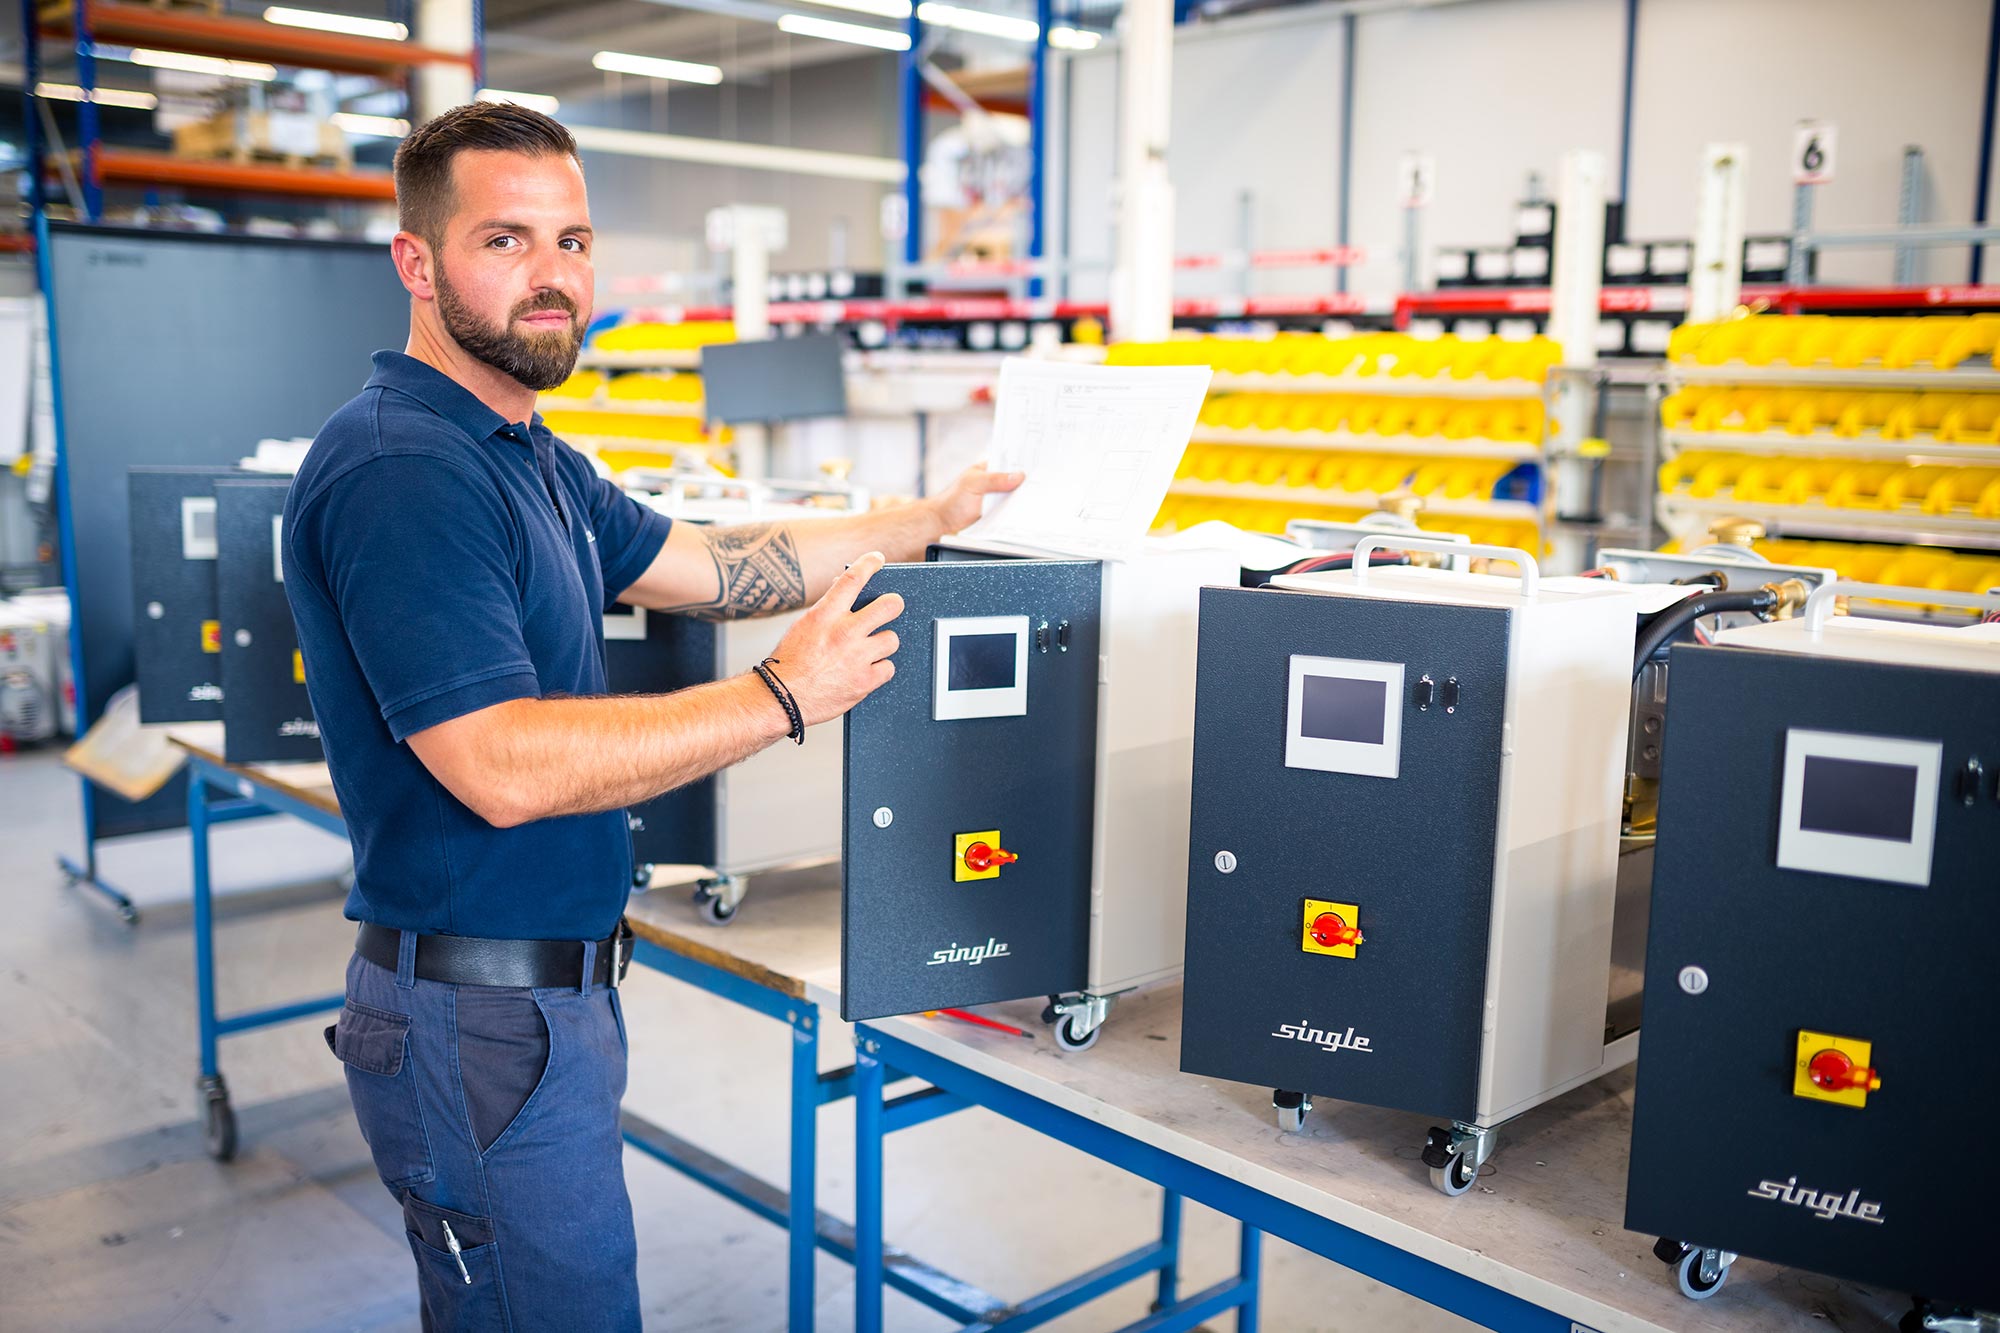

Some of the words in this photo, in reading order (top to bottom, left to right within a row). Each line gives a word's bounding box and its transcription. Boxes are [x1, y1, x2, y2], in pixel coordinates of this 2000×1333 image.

[1803, 136, 1825, 170] 6
[927, 938, 1011, 966] single
[1271, 1020, 1373, 1052] single
[1747, 1176, 1885, 1224] single
